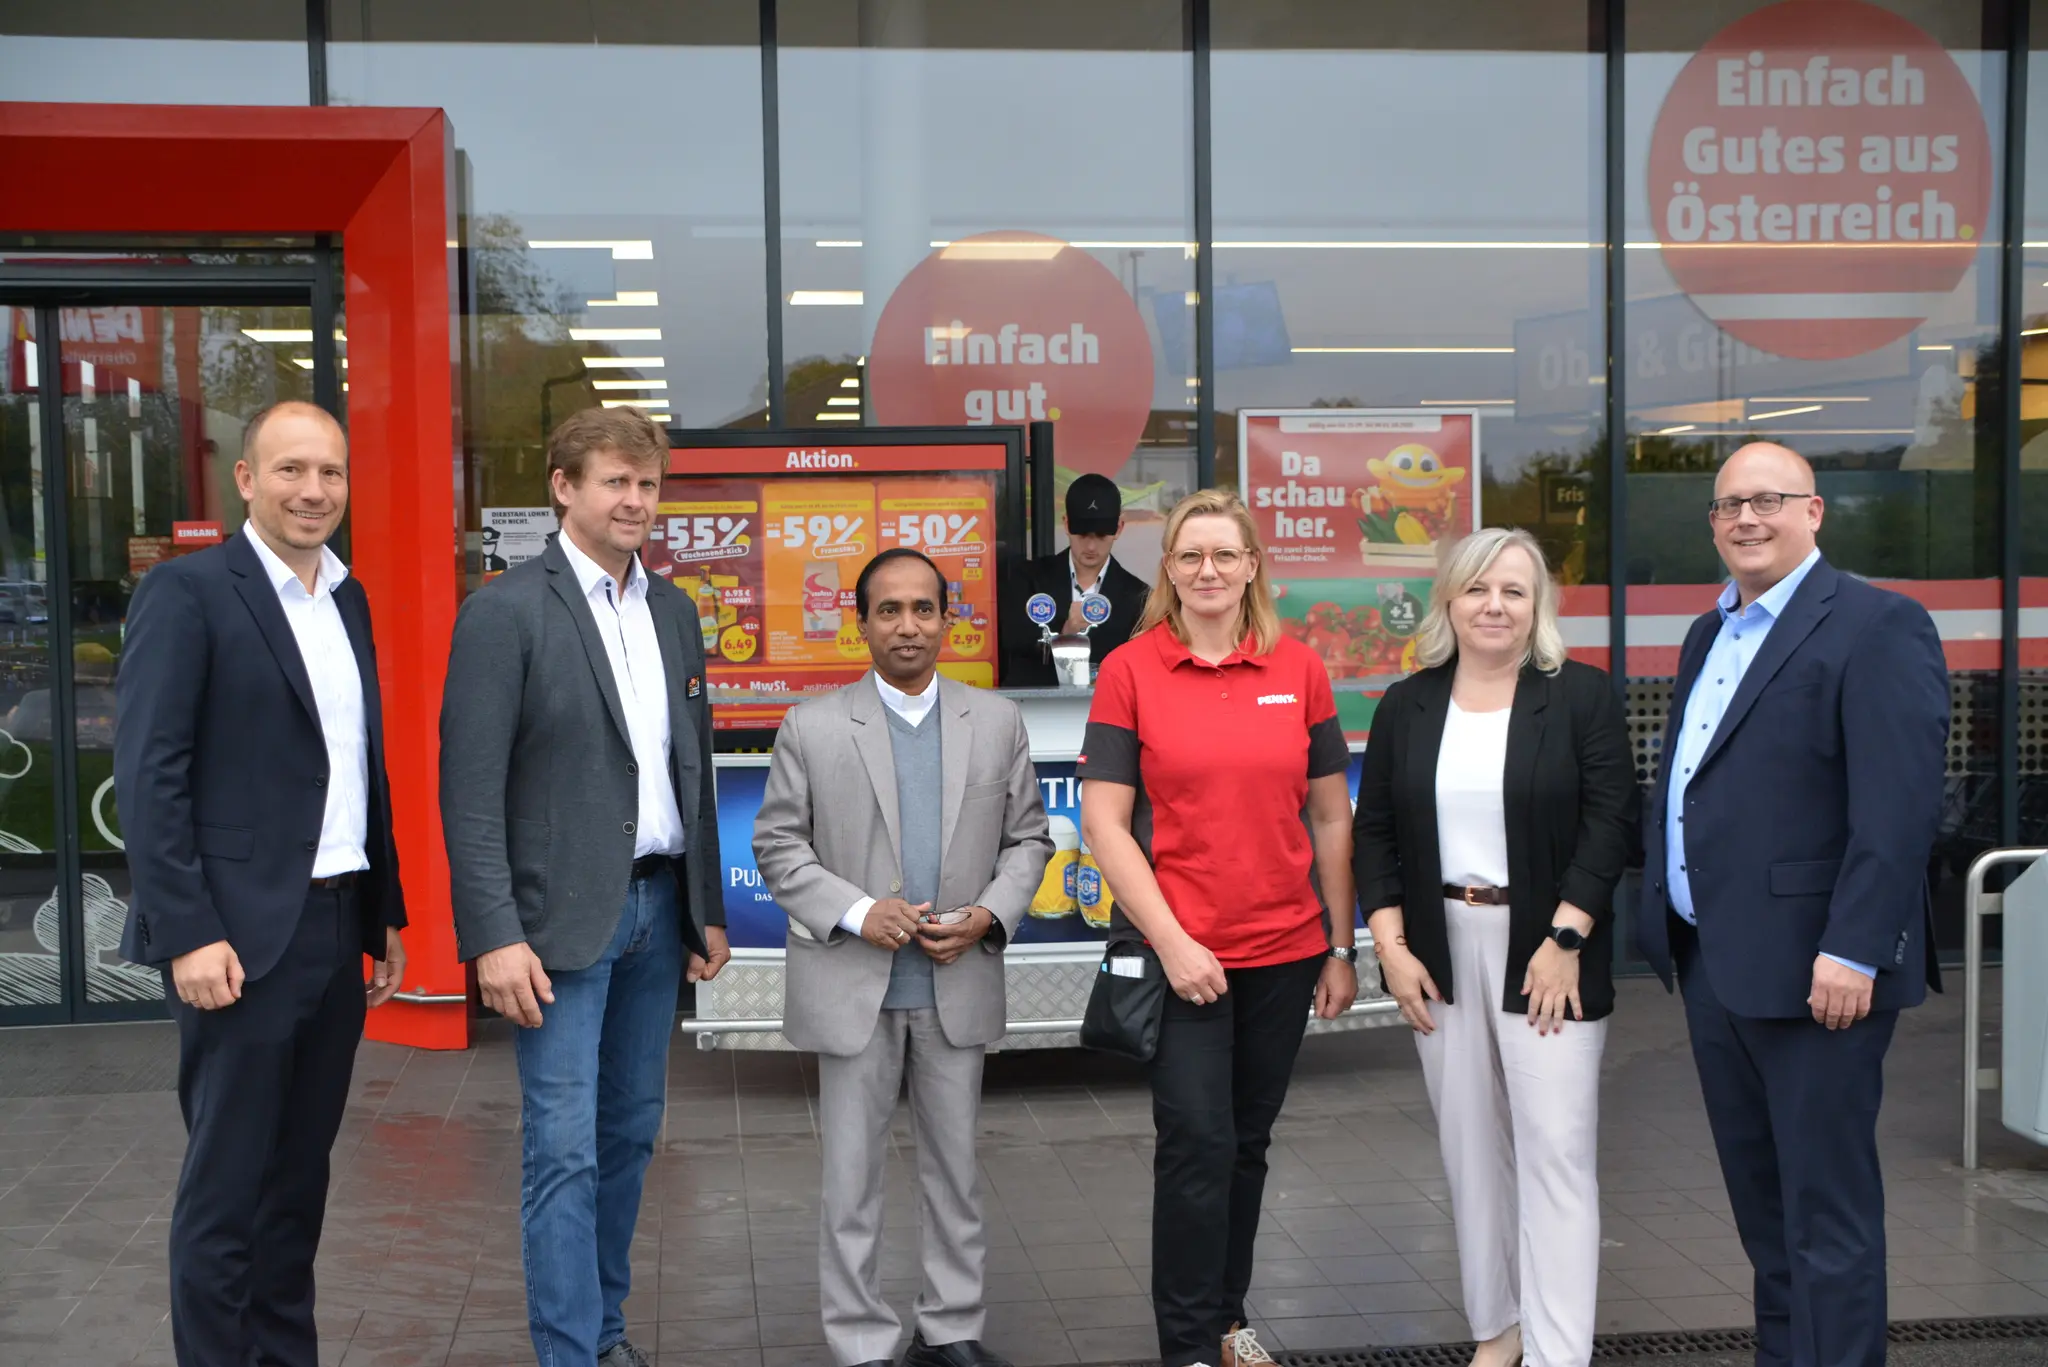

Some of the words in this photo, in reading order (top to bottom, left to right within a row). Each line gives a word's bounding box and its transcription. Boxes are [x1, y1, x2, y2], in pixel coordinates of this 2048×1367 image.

[1717, 51, 1925, 106] Einfach
[1683, 126, 1845, 174] Gutes
[1859, 135, 1958, 173] aus
[1667, 181, 1975, 242] Österreich.
[924, 319, 1099, 365] Einfach
[964, 382, 1061, 426] gut.
[786, 449, 859, 469] Aktion.
[1281, 451, 1321, 476] Da
[1256, 480, 1345, 508] schau
[177, 528, 218, 538] EINGANG
[650, 516, 751, 550] -55%
[766, 515, 865, 548] -59%
[881, 514, 981, 547] -50%
[1275, 511, 1335, 538] her.
[724, 639, 752, 650] 6.49
[953, 634, 981, 645] 2.99
[750, 680, 790, 692] MwSt.
[755, 893, 772, 902] DAS
